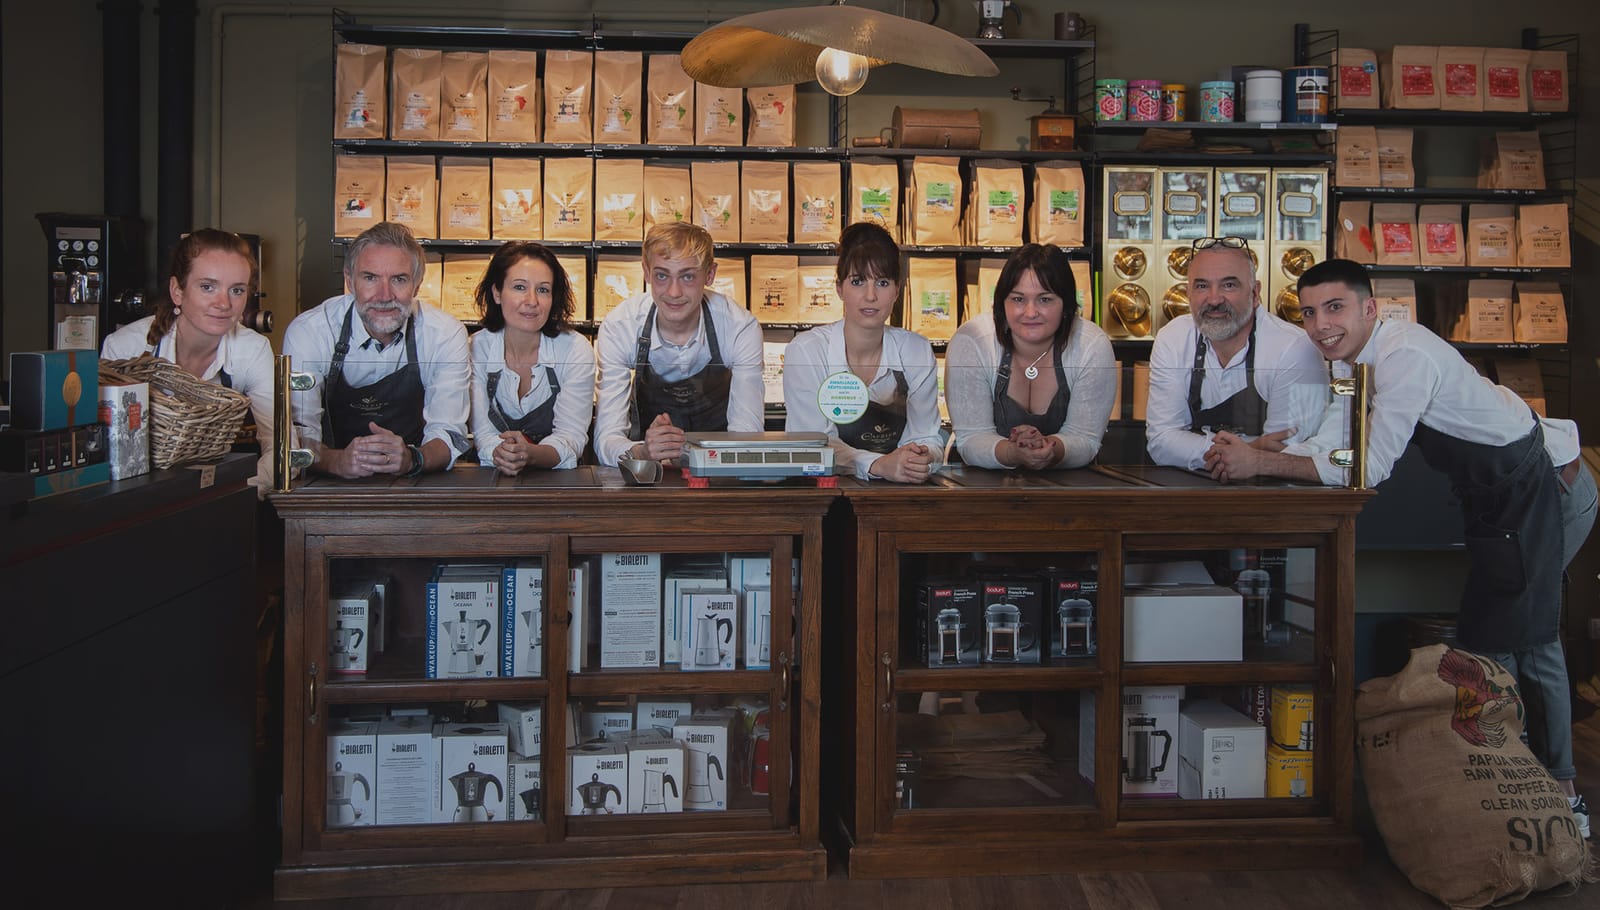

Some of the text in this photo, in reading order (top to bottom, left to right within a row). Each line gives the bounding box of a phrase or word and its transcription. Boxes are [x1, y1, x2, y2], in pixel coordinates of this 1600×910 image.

[620, 554, 648, 566] BIALETTI
[455, 592, 476, 600] BIALETTI
[712, 601, 734, 610] BIALETTI
[342, 606, 364, 616] BIALETTI
[656, 710, 679, 719] BIALETTI
[608, 719, 628, 728] BIALETTI
[691, 734, 715, 744] BIALETTI
[345, 744, 372, 755] BIALETTI
[396, 744, 417, 753] BIALETTI
[478, 745, 505, 756] BIALETTI
[601, 760, 624, 769] BIALETTI
[650, 756, 668, 765] BIALETTI
[1468, 754, 1510, 766] PAPUA
[1462, 766, 1546, 781] RAW WASHED
[1497, 780, 1546, 795] COFFEE
[1480, 796, 1564, 811] CLEAN SOUND
